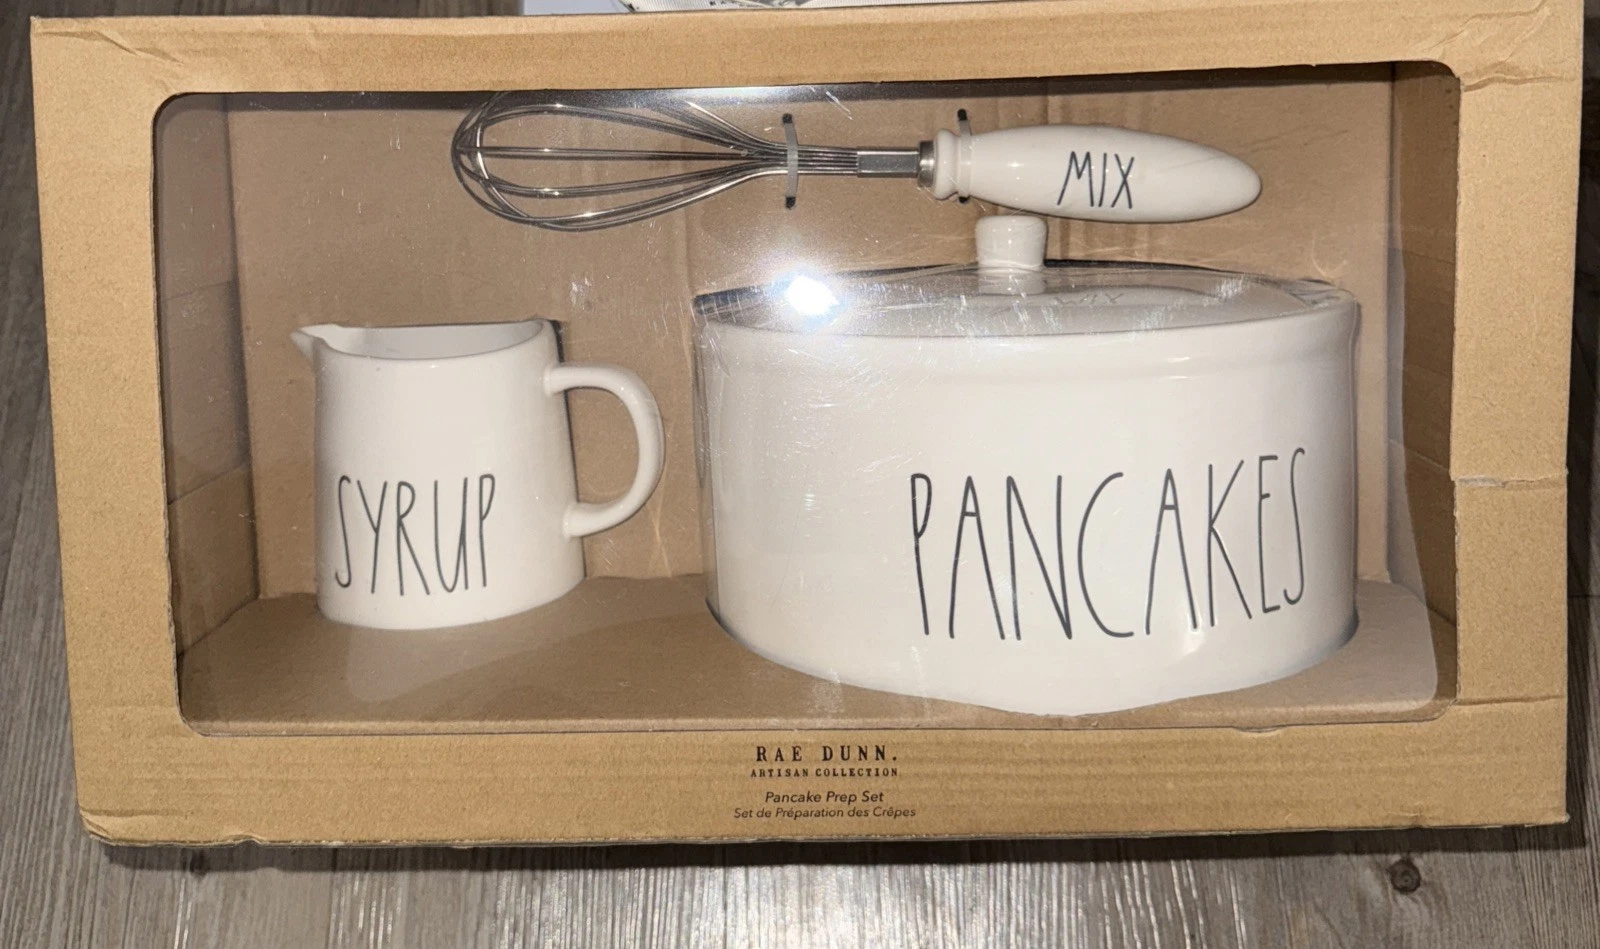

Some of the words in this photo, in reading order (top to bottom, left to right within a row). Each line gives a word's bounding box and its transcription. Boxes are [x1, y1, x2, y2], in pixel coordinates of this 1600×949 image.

[1057, 150, 1135, 210] MIX
[334, 473, 496, 596] SYRUP
[910, 447, 1306, 640] PANCAKES
[756, 745, 802, 762] RAE
[821, 744, 898, 762] DUNN.
[750, 768, 809, 778] ARTISAN
[815, 767, 898, 777] COLLECTION
[765, 790, 822, 803] Pancake
[826, 791, 857, 805] Prep
[861, 790, 885, 803] Set
[733, 808, 753, 819] Set
[756, 807, 772, 818] de
[775, 807, 844, 820] Préparation
[847, 806, 869, 818] des
[873, 806, 916, 819] Crêpes
